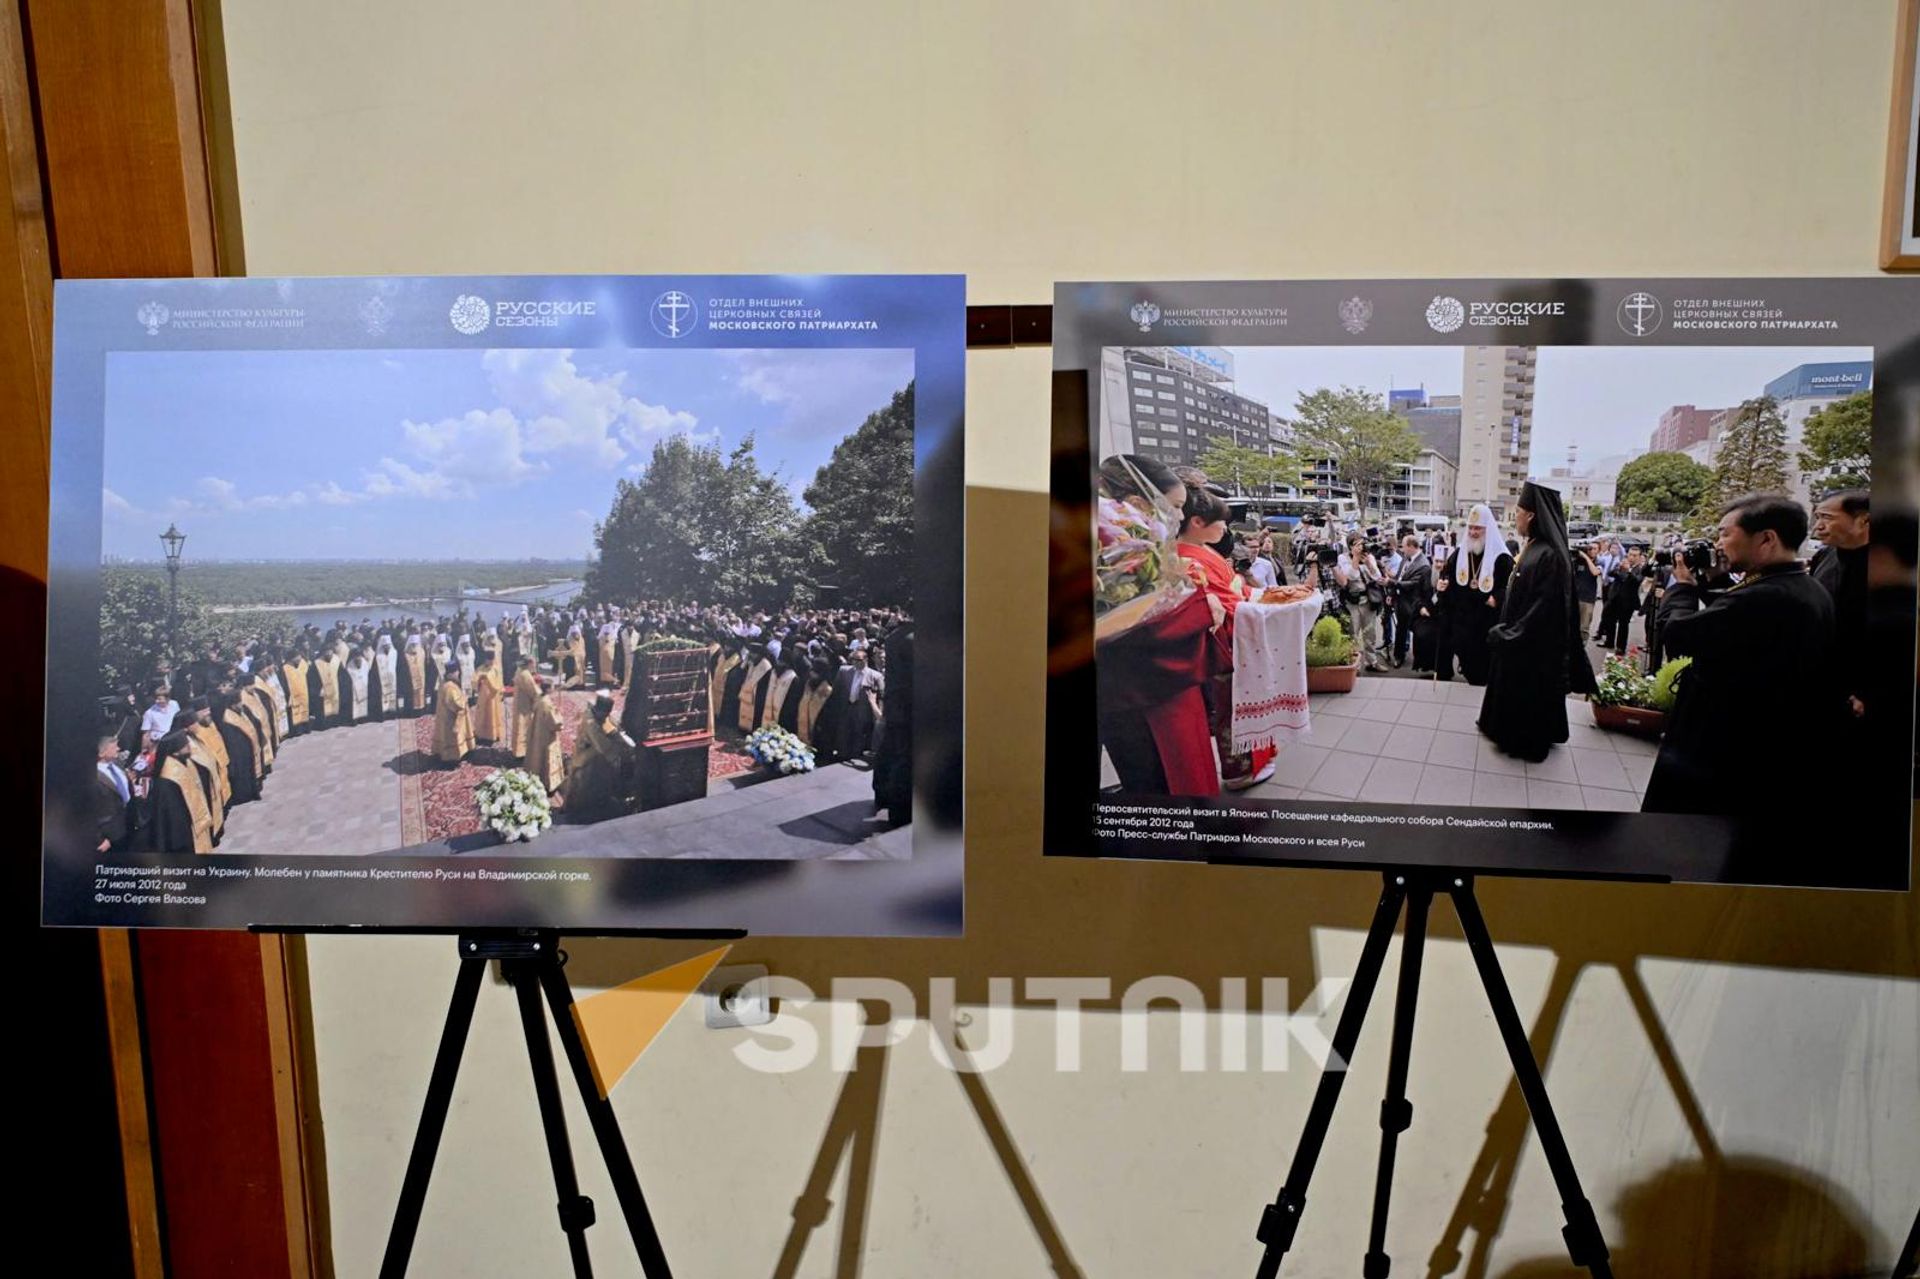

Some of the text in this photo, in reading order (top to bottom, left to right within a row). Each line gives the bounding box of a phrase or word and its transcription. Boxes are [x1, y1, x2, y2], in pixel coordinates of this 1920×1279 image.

[496, 301, 596, 315] РУССКИЕ
[709, 298, 803, 308] ОТДЕЛ ВНЕШНИХ
[1469, 302, 1565, 315] РУССКИЕ
[1674, 299, 1765, 308] ОТДЕЛ ВНЕШНИХ
[709, 308, 821, 319] ЦЕРКОВНЫХ СВЯЗЕЙ
[1164, 308, 1288, 317] МИНИСТЕРСТВО КУЛЬТУРЫ
[1674, 308, 1783, 319] ЦЕРКОВНЫХ СВЯЗЕЙ
[496, 316, 558, 327] СЕЗОНЫ
[709, 320, 878, 331] МОСКОВСКОГО ПАТРИАРХАТА
[1164, 317, 1288, 326] РОССИЙСКОЙ ФЕДЕРАЦИИ
[1469, 315, 1529, 326] СЕЗОНЫ
[1673, 320, 1838, 329] МОСКОВСКОГО ПАТРИАРХАТА
[1092, 802, 1554, 830] Первосвятительский визит в Японию. Посещение кафедрального собора Сендайской епархии.
[1092, 815, 1194, 829] 15 сентября 2012 года
[1092, 828, 1116, 838] Фото
[1118, 828, 1187, 841] Пресс-службы
[1190, 832, 1240, 844] Патриарха
[1243, 834, 1306, 846] Московского
[1316, 839, 1339, 847] всея
[1341, 837, 1365, 849] Руси
[95, 864, 592, 882] Патриарший визит на Украину. Молебен у памятника Крестителю Руси на Владимирской горке.
[95, 879, 187, 890] 27 июля 2012 года
[95, 893, 207, 905] Фото Сергея Власова
